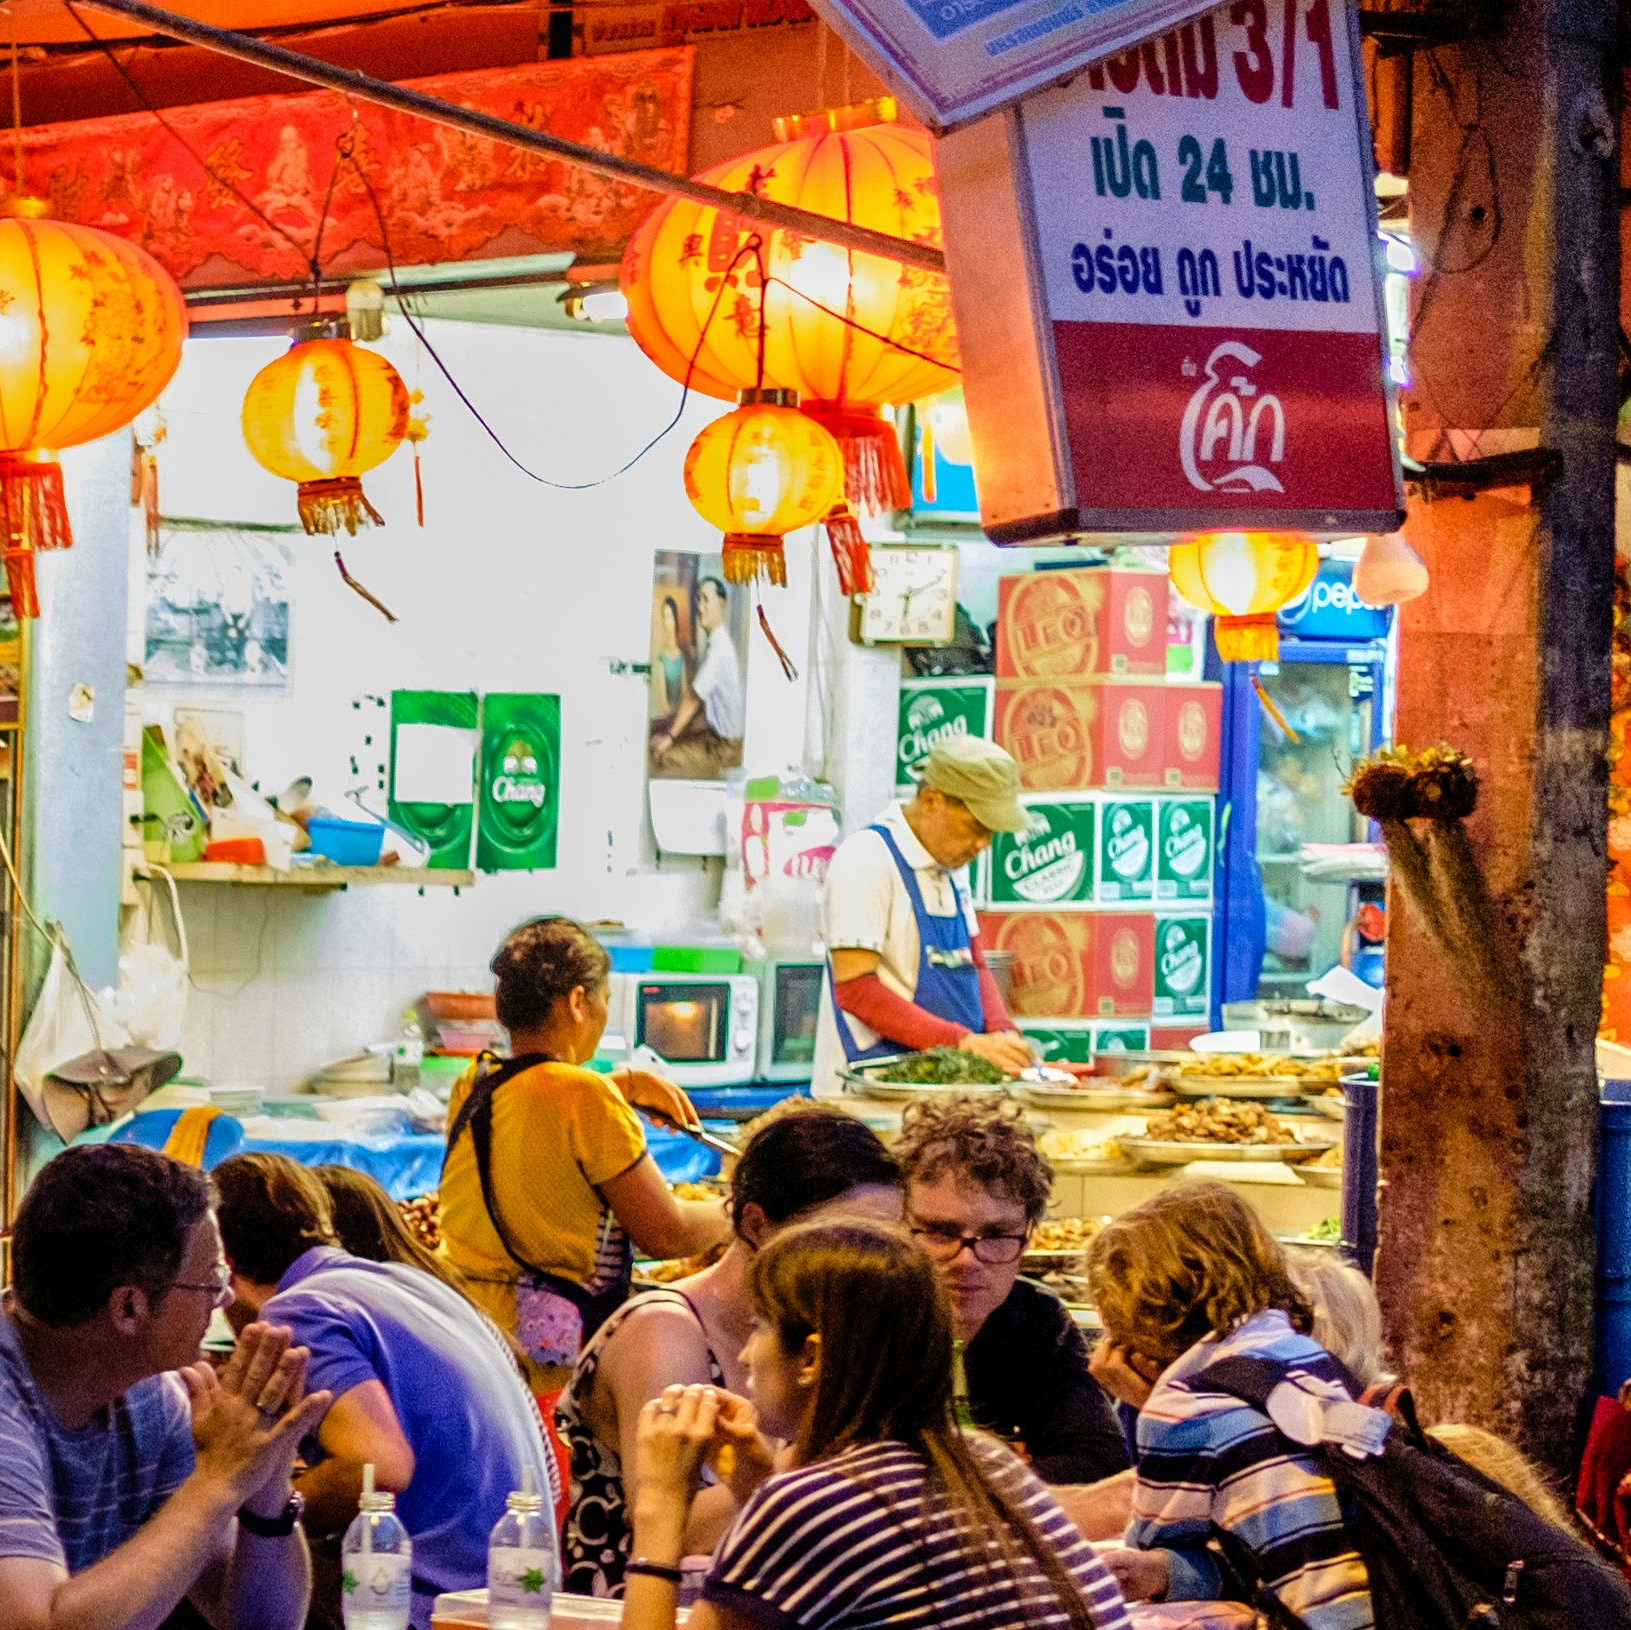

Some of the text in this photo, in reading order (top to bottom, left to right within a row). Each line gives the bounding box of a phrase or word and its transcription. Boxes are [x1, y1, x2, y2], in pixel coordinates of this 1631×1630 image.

[1091, 106, 1316, 211] เปิด 24 ชม.
[1072, 229, 1350, 318] อร่อย ถูก ประหยัด
[1310, 581, 1386, 616] pep
[1015, 606, 1087, 645] LEO
[1013, 722, 1080, 760] LEO
[492, 776, 546, 808] Chang
[1004, 830, 1077, 881] Chang
